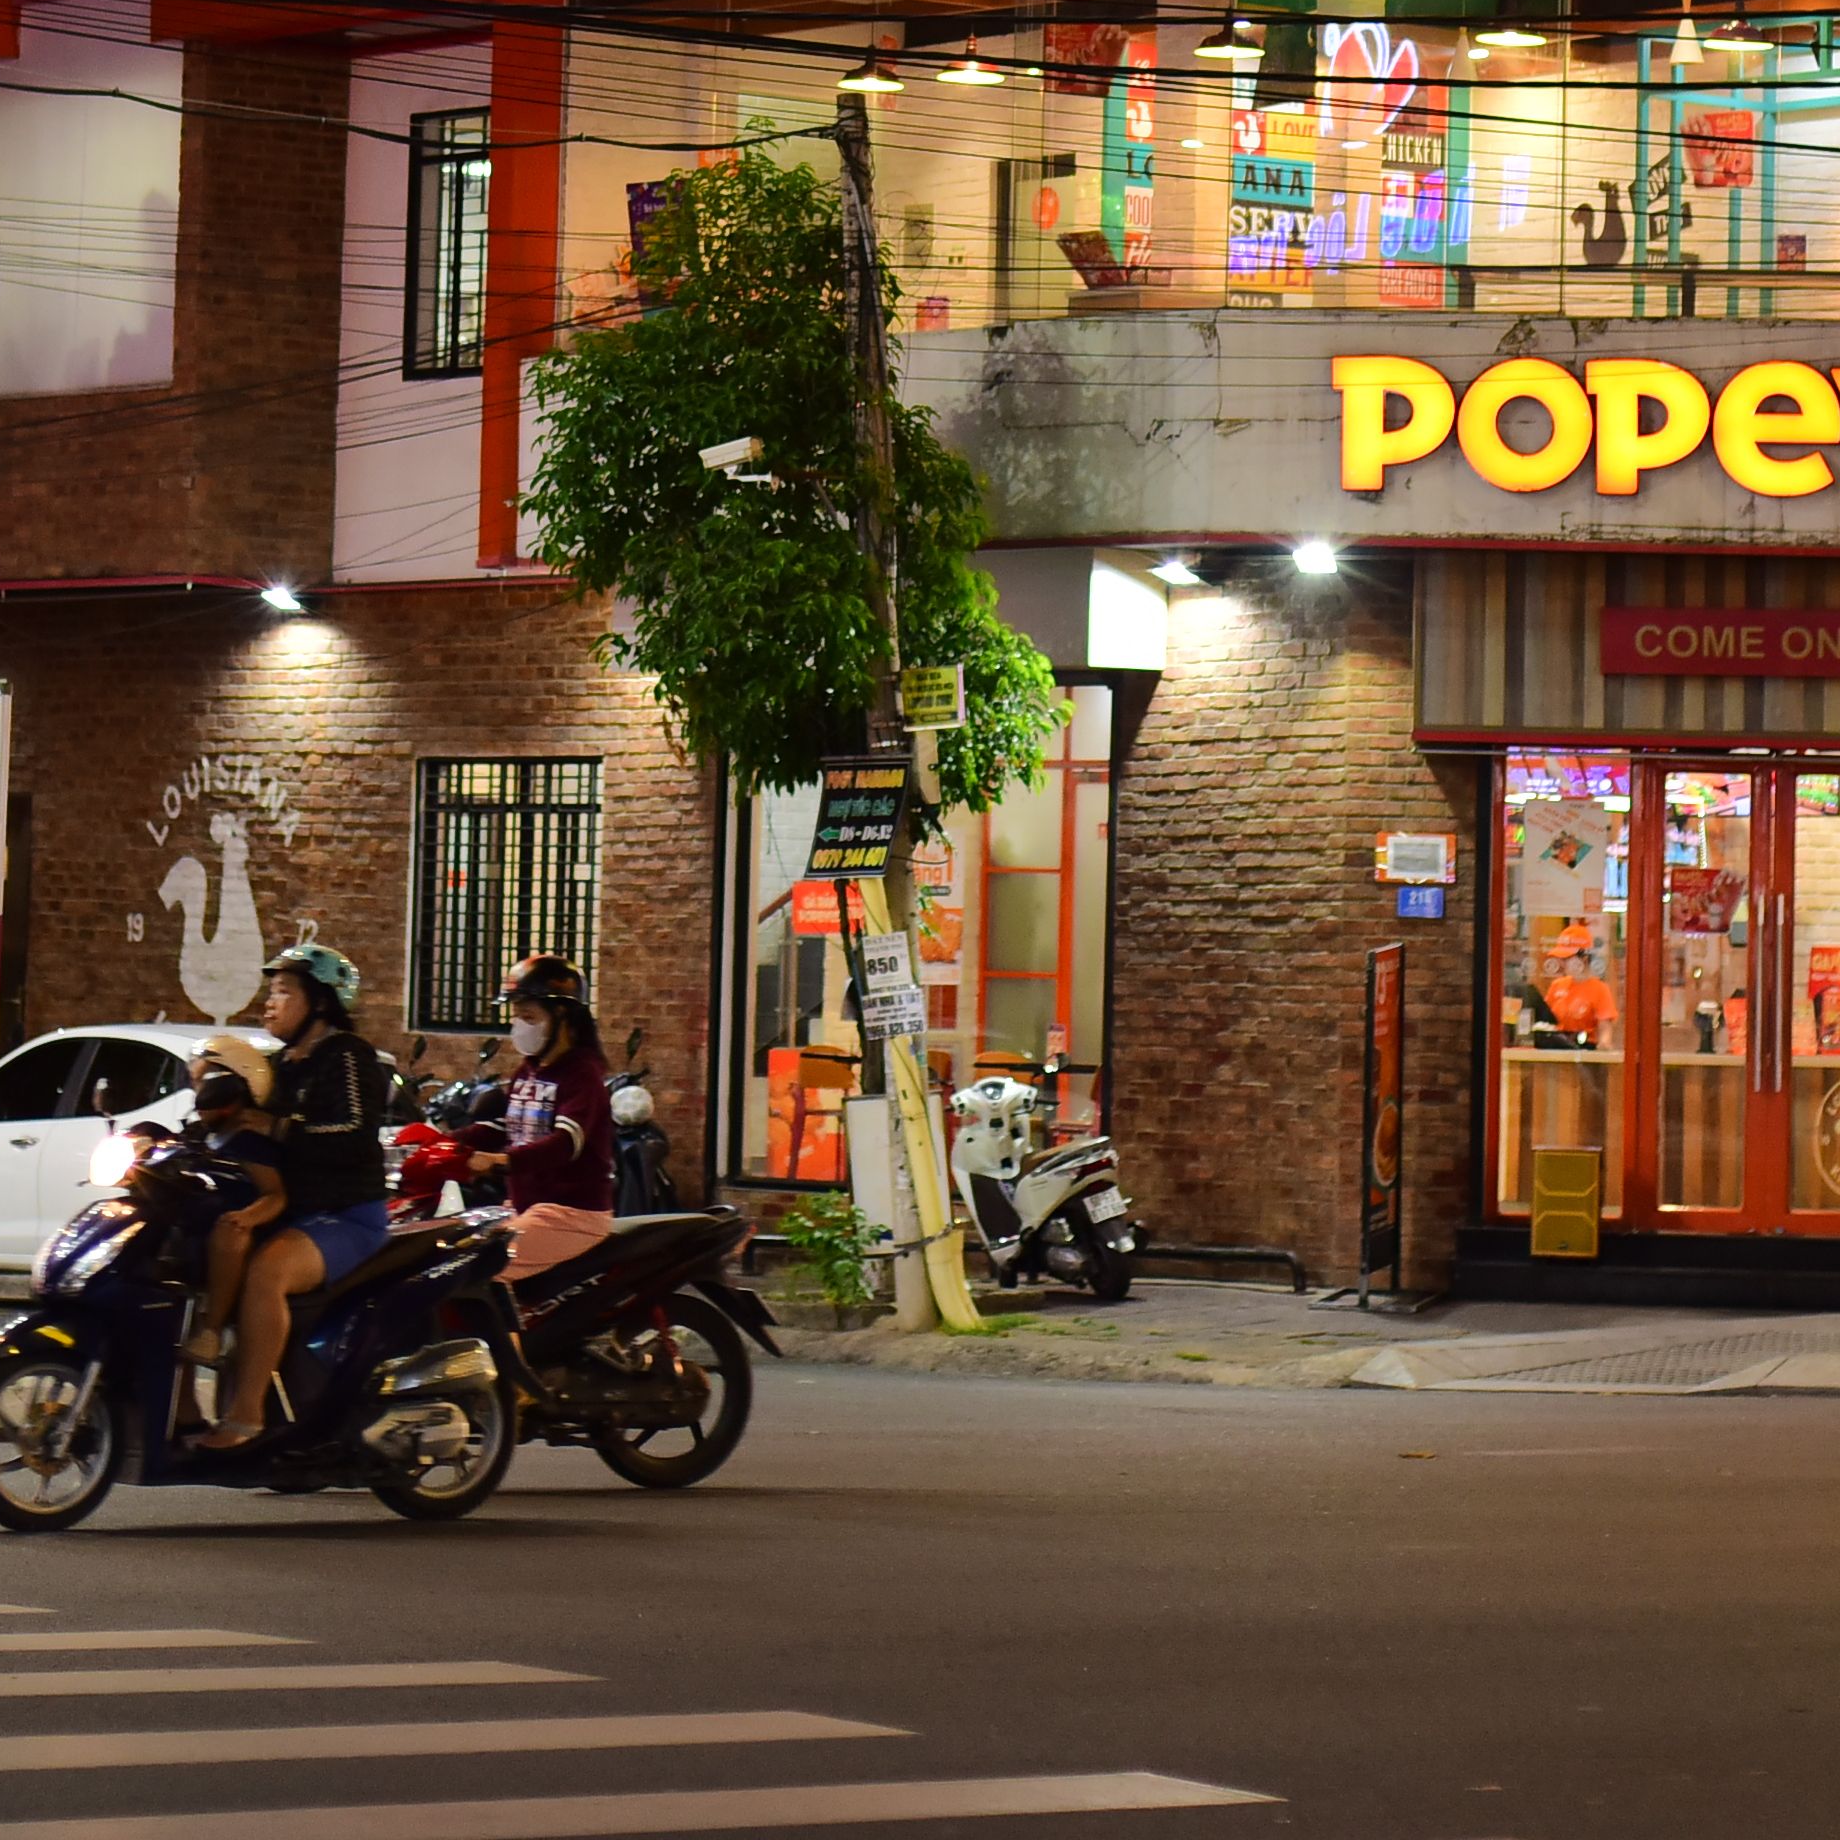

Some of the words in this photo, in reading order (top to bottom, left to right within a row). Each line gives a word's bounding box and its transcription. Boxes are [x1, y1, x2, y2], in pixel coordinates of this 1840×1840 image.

[1241, 162, 1307, 198] ANA
[1633, 621, 1767, 663] COME
[126, 912, 145, 943] 19
[866, 956, 899, 976] 850
